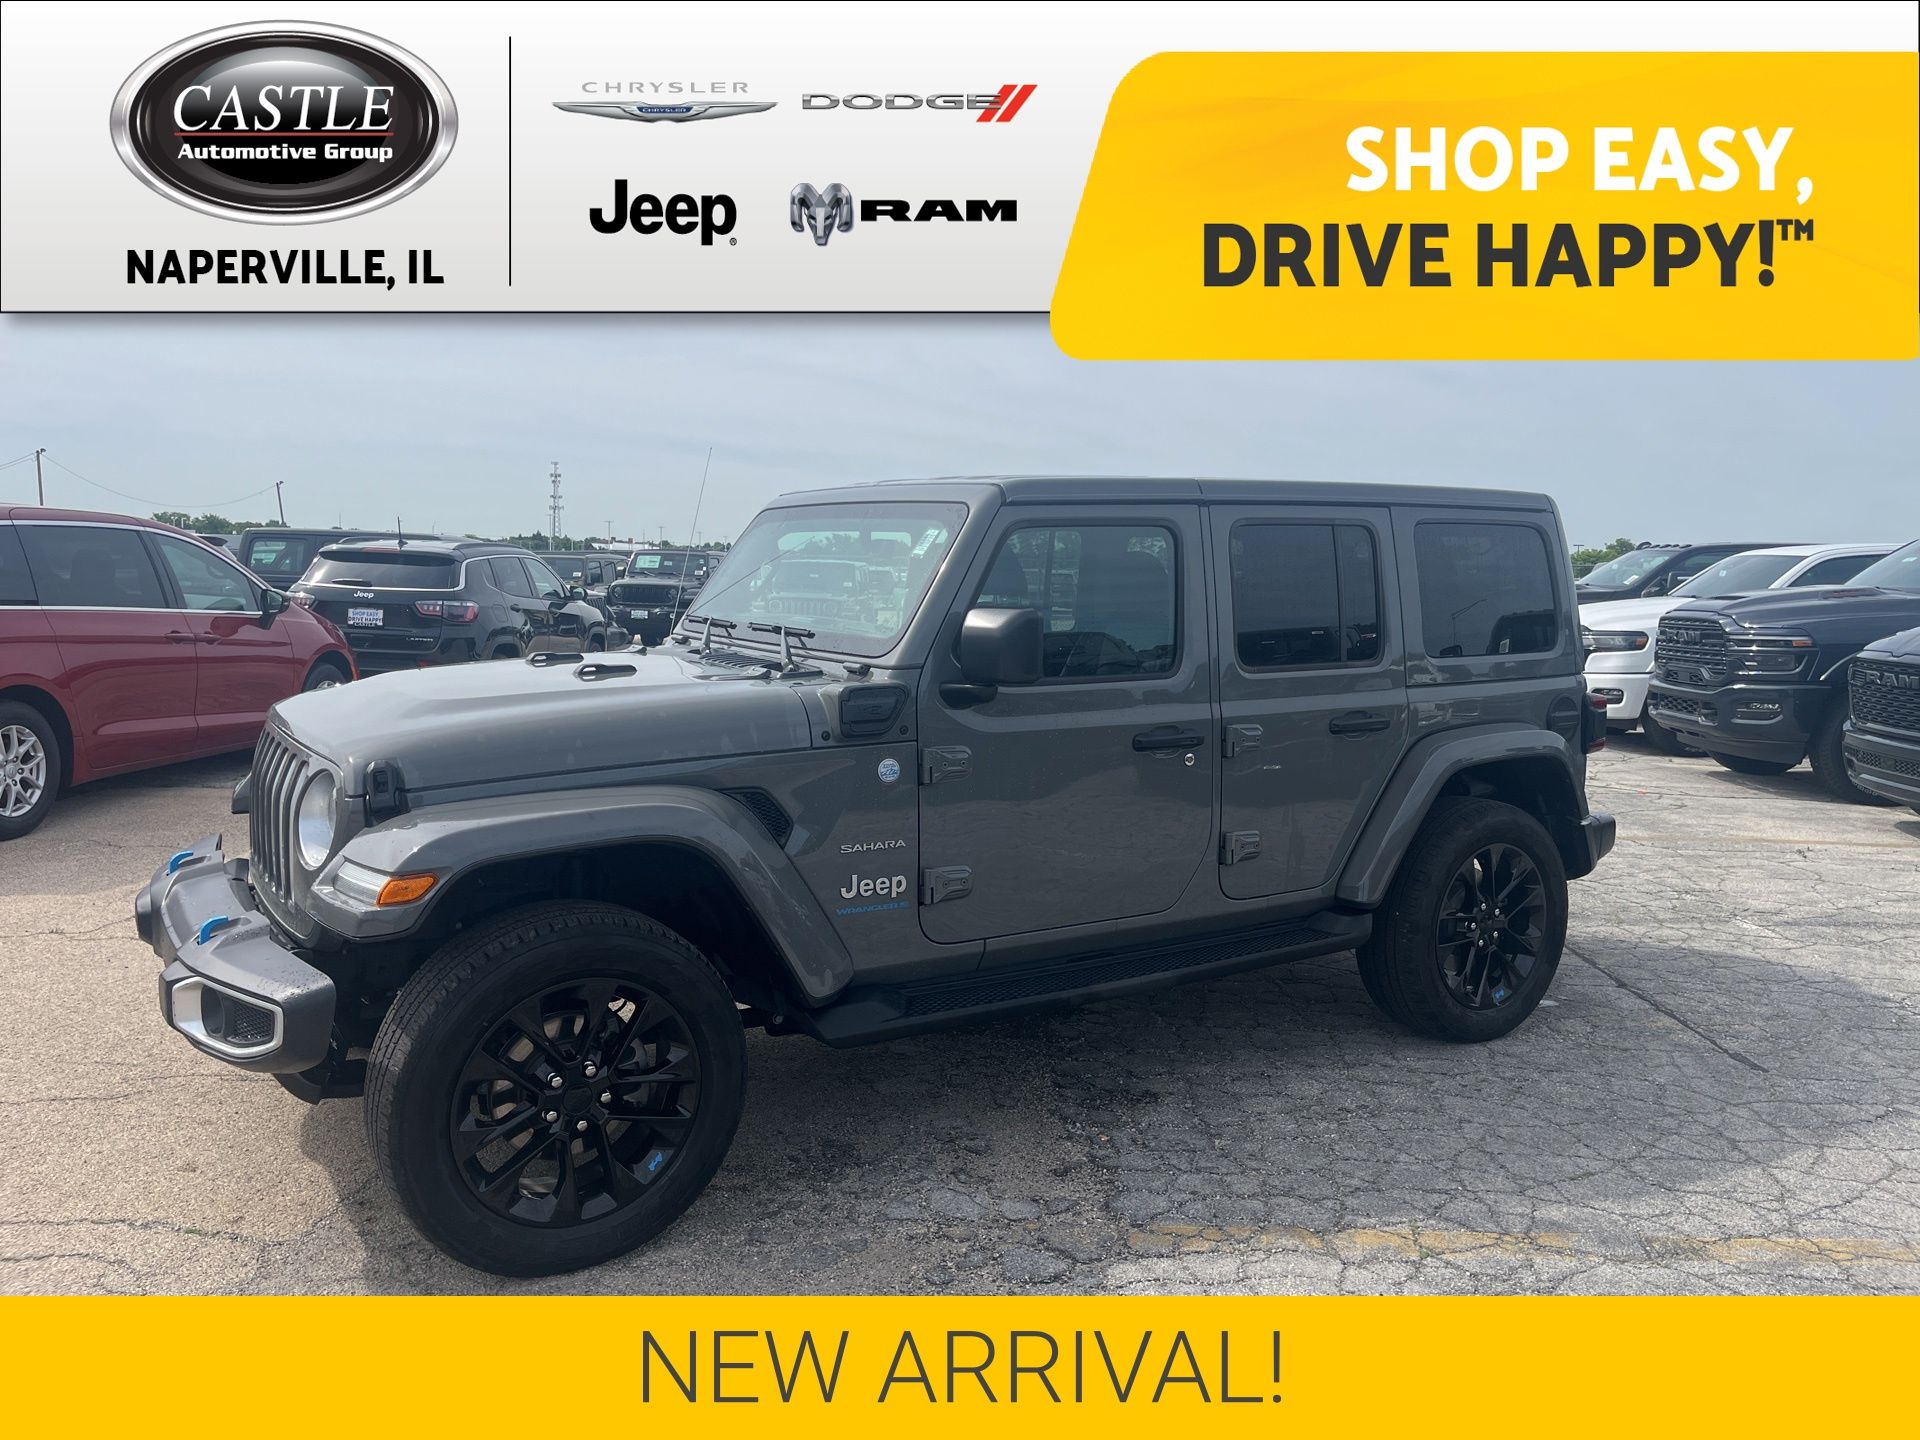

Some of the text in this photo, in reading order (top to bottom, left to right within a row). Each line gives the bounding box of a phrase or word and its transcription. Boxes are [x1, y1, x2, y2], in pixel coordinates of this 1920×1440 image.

[353, 590, 375, 599] Jeep
[1865, 669, 1920, 689] RAM
[840, 839, 907, 854] SAHARA
[840, 874, 908, 899] Jeep
